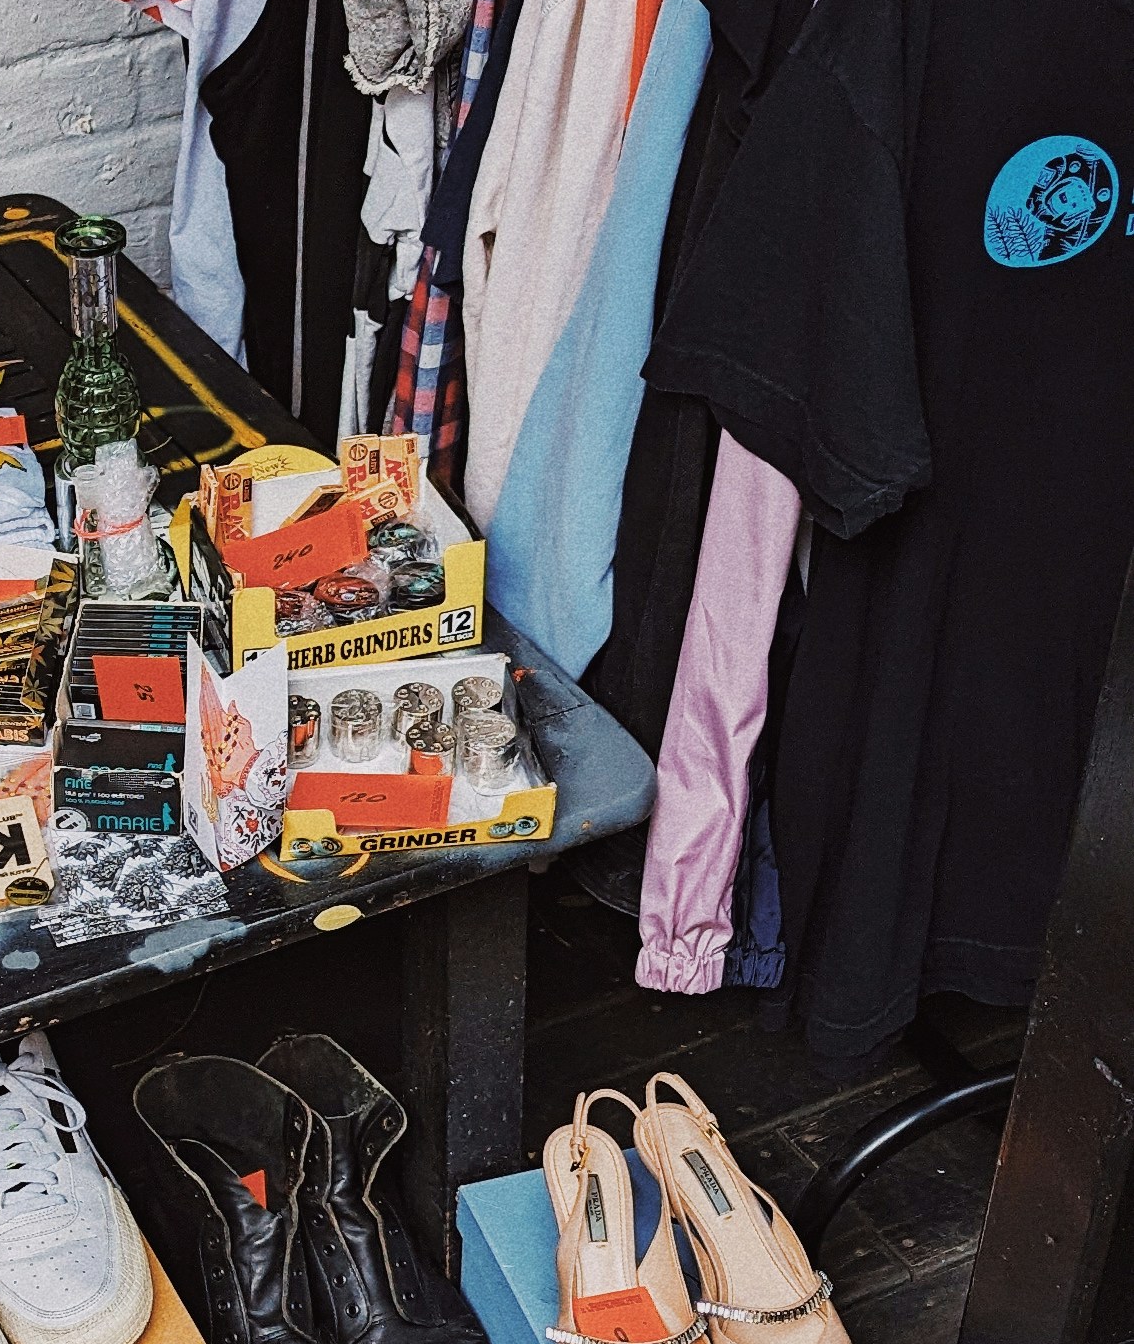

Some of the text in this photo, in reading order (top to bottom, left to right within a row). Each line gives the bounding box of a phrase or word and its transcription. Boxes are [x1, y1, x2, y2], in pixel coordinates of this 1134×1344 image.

[272, 543, 314, 571] 240
[442, 610, 471, 634] 12
[287, 622, 433, 670] HERB GRINDERS
[97, 815, 162, 832] MARIE
[359, 828, 477, 852] GRINDER
[699, 1165, 721, 1195] PRADA
[590, 1191, 604, 1223] PRADA
